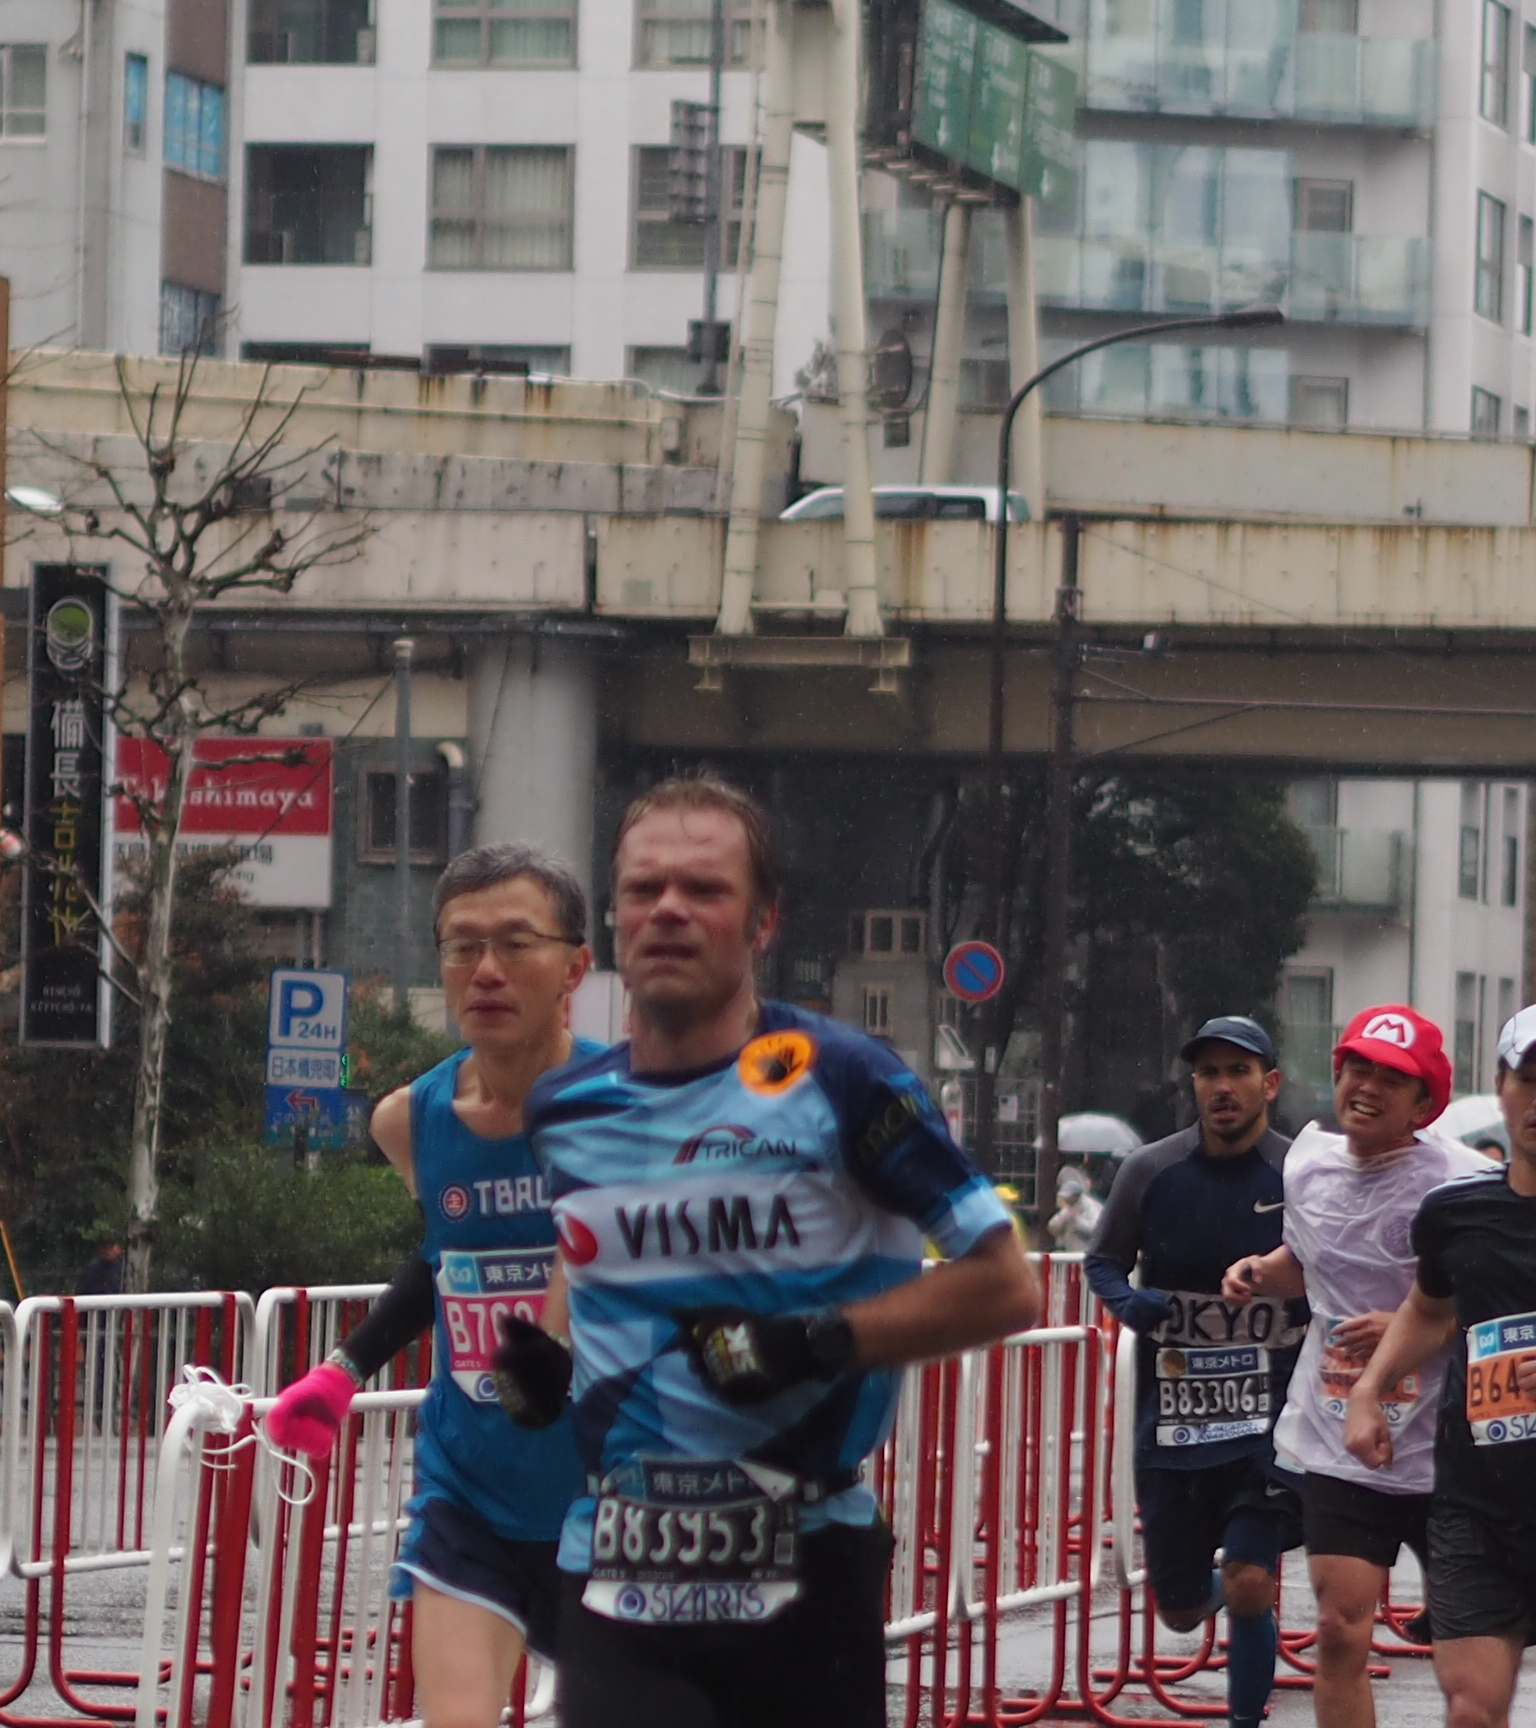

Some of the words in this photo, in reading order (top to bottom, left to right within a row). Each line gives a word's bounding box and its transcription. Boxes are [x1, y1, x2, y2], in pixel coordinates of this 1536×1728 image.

[114, 776, 314, 815] Takshimaya
[278, 980, 324, 1037] P
[298, 1021, 337, 1040] 24H
[271, 1055, 336, 1080] 日本橋兜町
[703, 1139, 797, 1160] TRICAN
[615, 1194, 801, 1260] VISMA
[485, 1261, 552, 1283] 東京メト
[1156, 1296, 1274, 1342] OKYO
[1192, 1353, 1254, 1370] 東京メトロ
[1159, 1377, 1256, 1416] B83306
[653, 1472, 746, 1494] 東京メト
